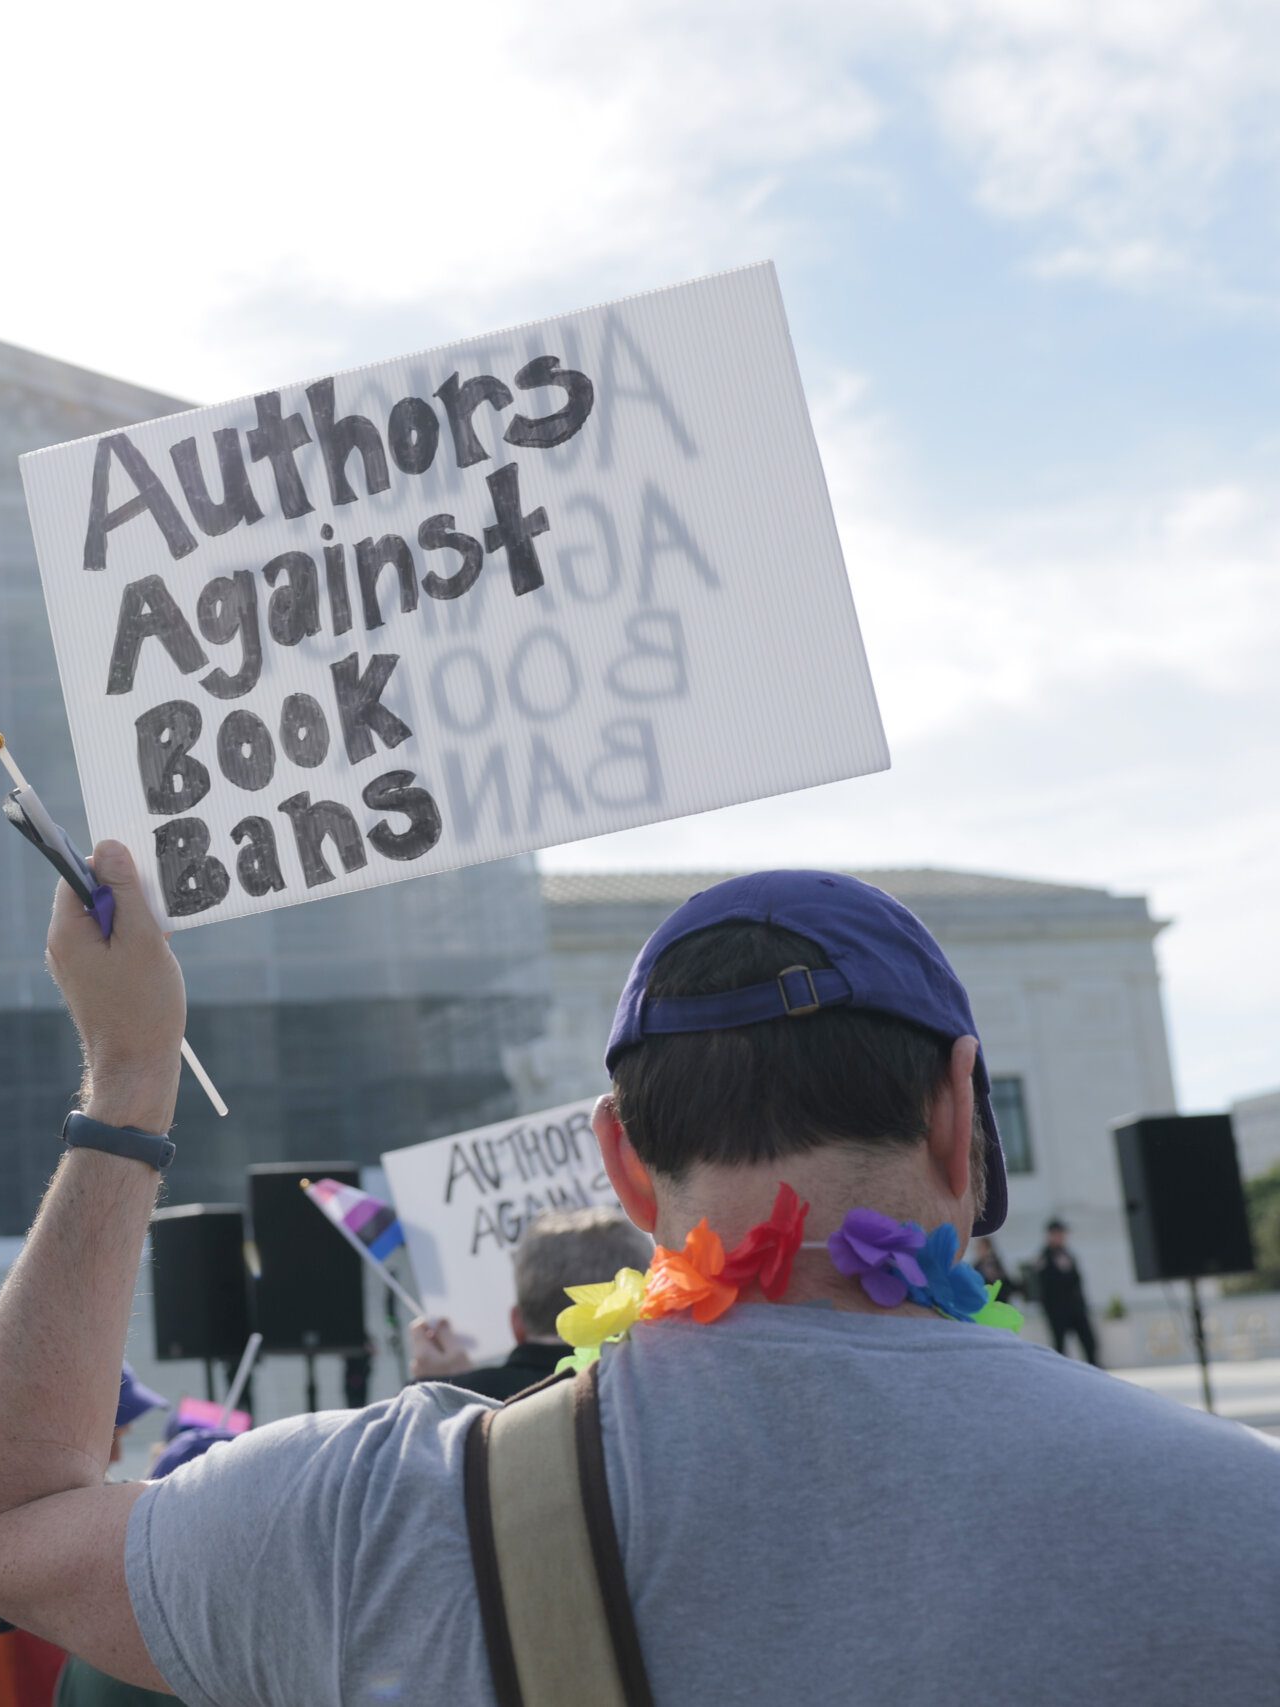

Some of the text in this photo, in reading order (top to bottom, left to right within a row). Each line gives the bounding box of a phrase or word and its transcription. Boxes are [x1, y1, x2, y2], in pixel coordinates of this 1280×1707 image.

[83, 354, 595, 571] Authors
[106, 461, 550, 699] Against
[154, 769, 441, 918] Bans
